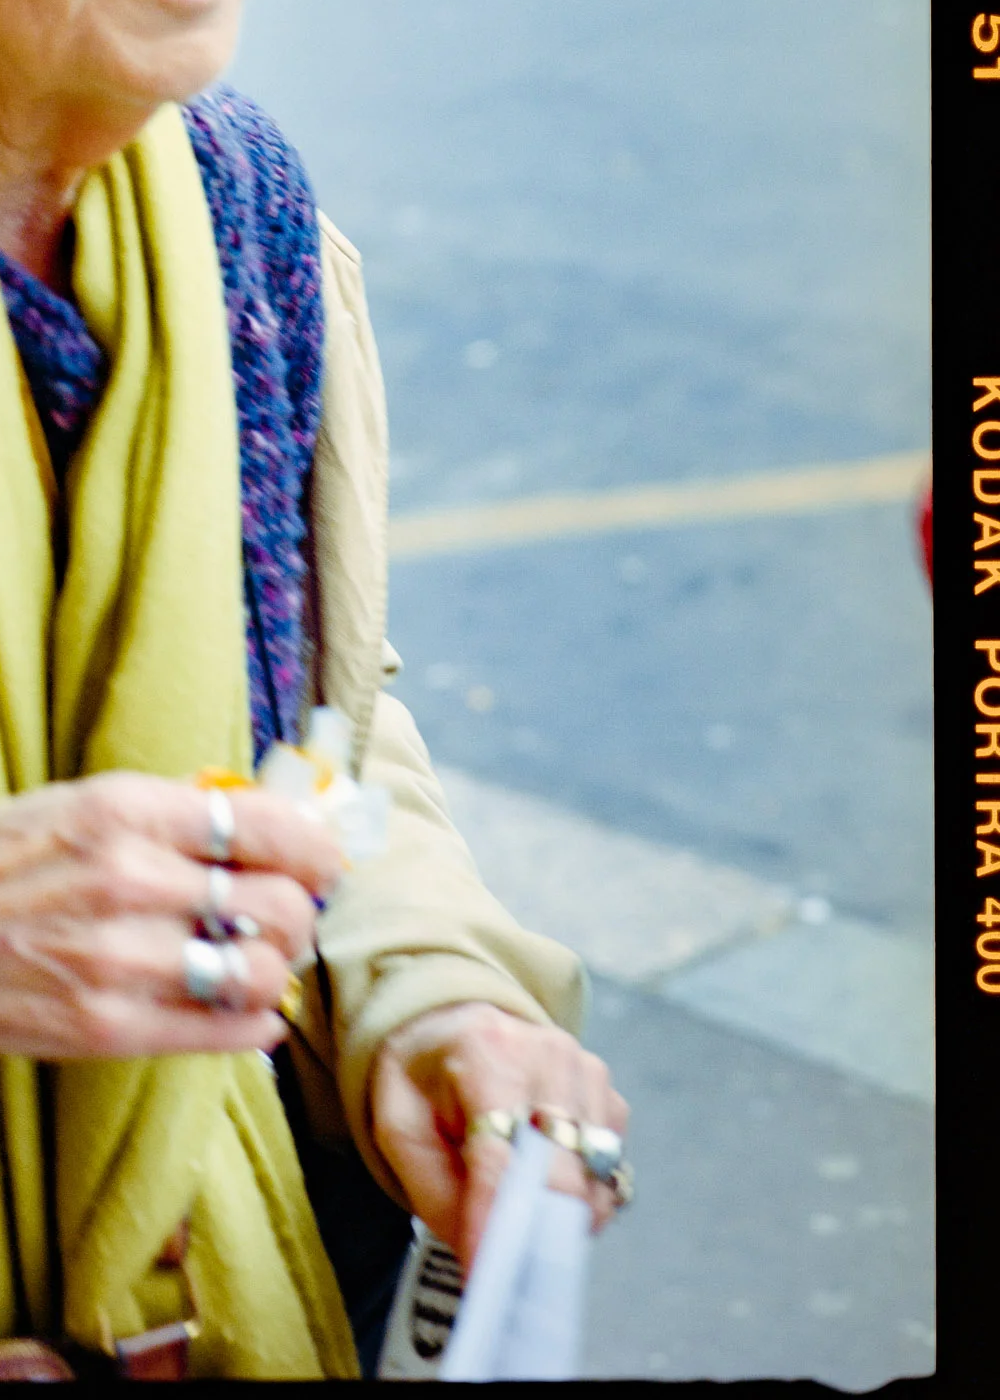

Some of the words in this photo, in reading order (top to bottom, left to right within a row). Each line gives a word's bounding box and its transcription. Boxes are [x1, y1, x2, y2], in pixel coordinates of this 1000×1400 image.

[971, 12, 1000, 80] 51
[971, 375, 1000, 596] KODAK
[973, 638, 1000, 878] PORTRA
[975, 896, 1000, 995] 400
